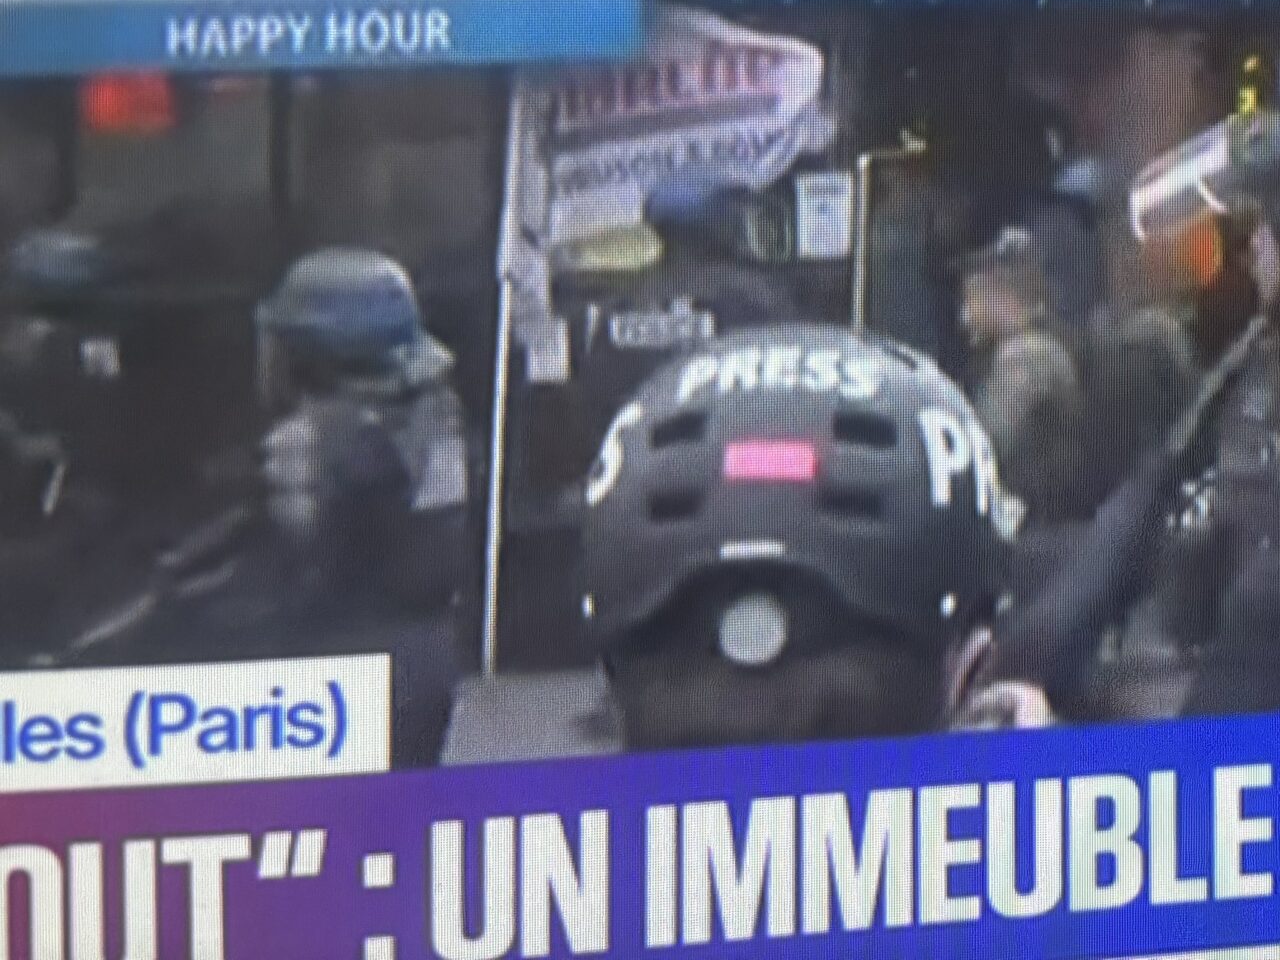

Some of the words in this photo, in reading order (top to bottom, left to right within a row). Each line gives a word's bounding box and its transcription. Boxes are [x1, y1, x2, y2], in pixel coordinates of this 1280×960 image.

[166, 12, 312, 58] HAPPY
[325, 6, 452, 56] HOUR
[676, 344, 881, 404] PRESS
[2, 698, 106, 764] les
[124, 679, 348, 770] (Paris)
[430, 808, 610, 960] UN
[644, 762, 1274, 948] IMMEUBLE
